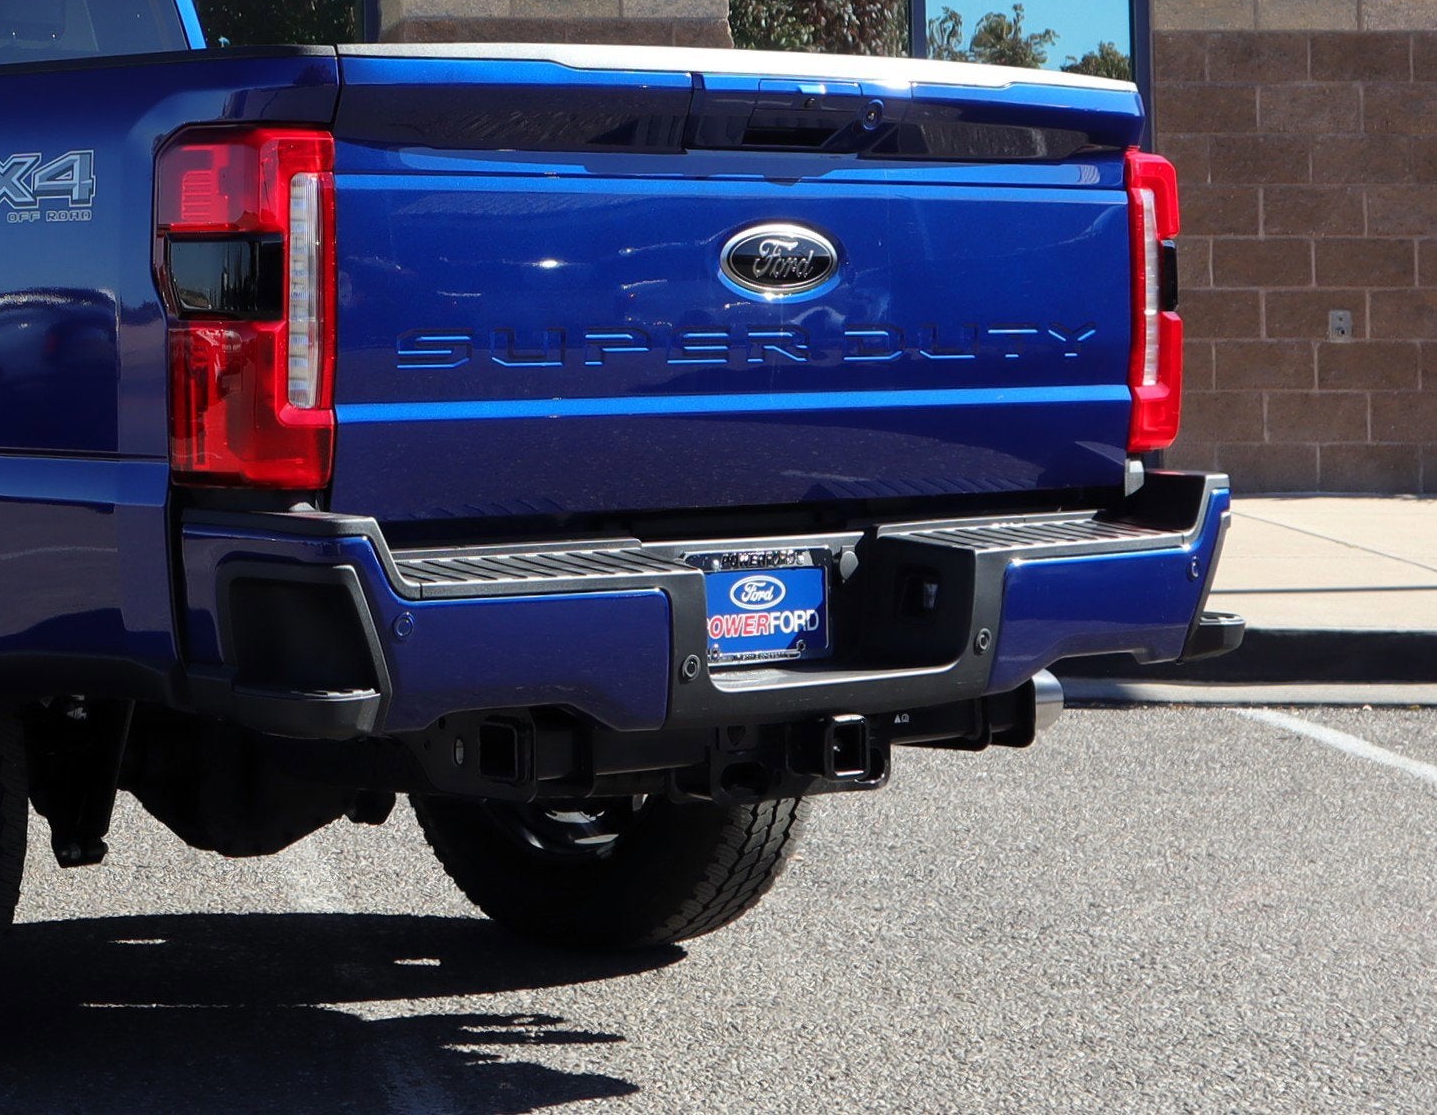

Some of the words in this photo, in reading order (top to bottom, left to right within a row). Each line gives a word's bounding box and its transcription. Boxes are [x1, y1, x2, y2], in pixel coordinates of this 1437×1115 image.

[7, 211, 40, 223] OFF
[46, 210, 92, 222] ROAD
[753, 238, 814, 278] Ford
[397, 326, 809, 368] SUPER
[844, 323, 1097, 361] DUTY
[741, 581, 774, 603] Ford
[707, 609, 819, 639] OWERFORD
